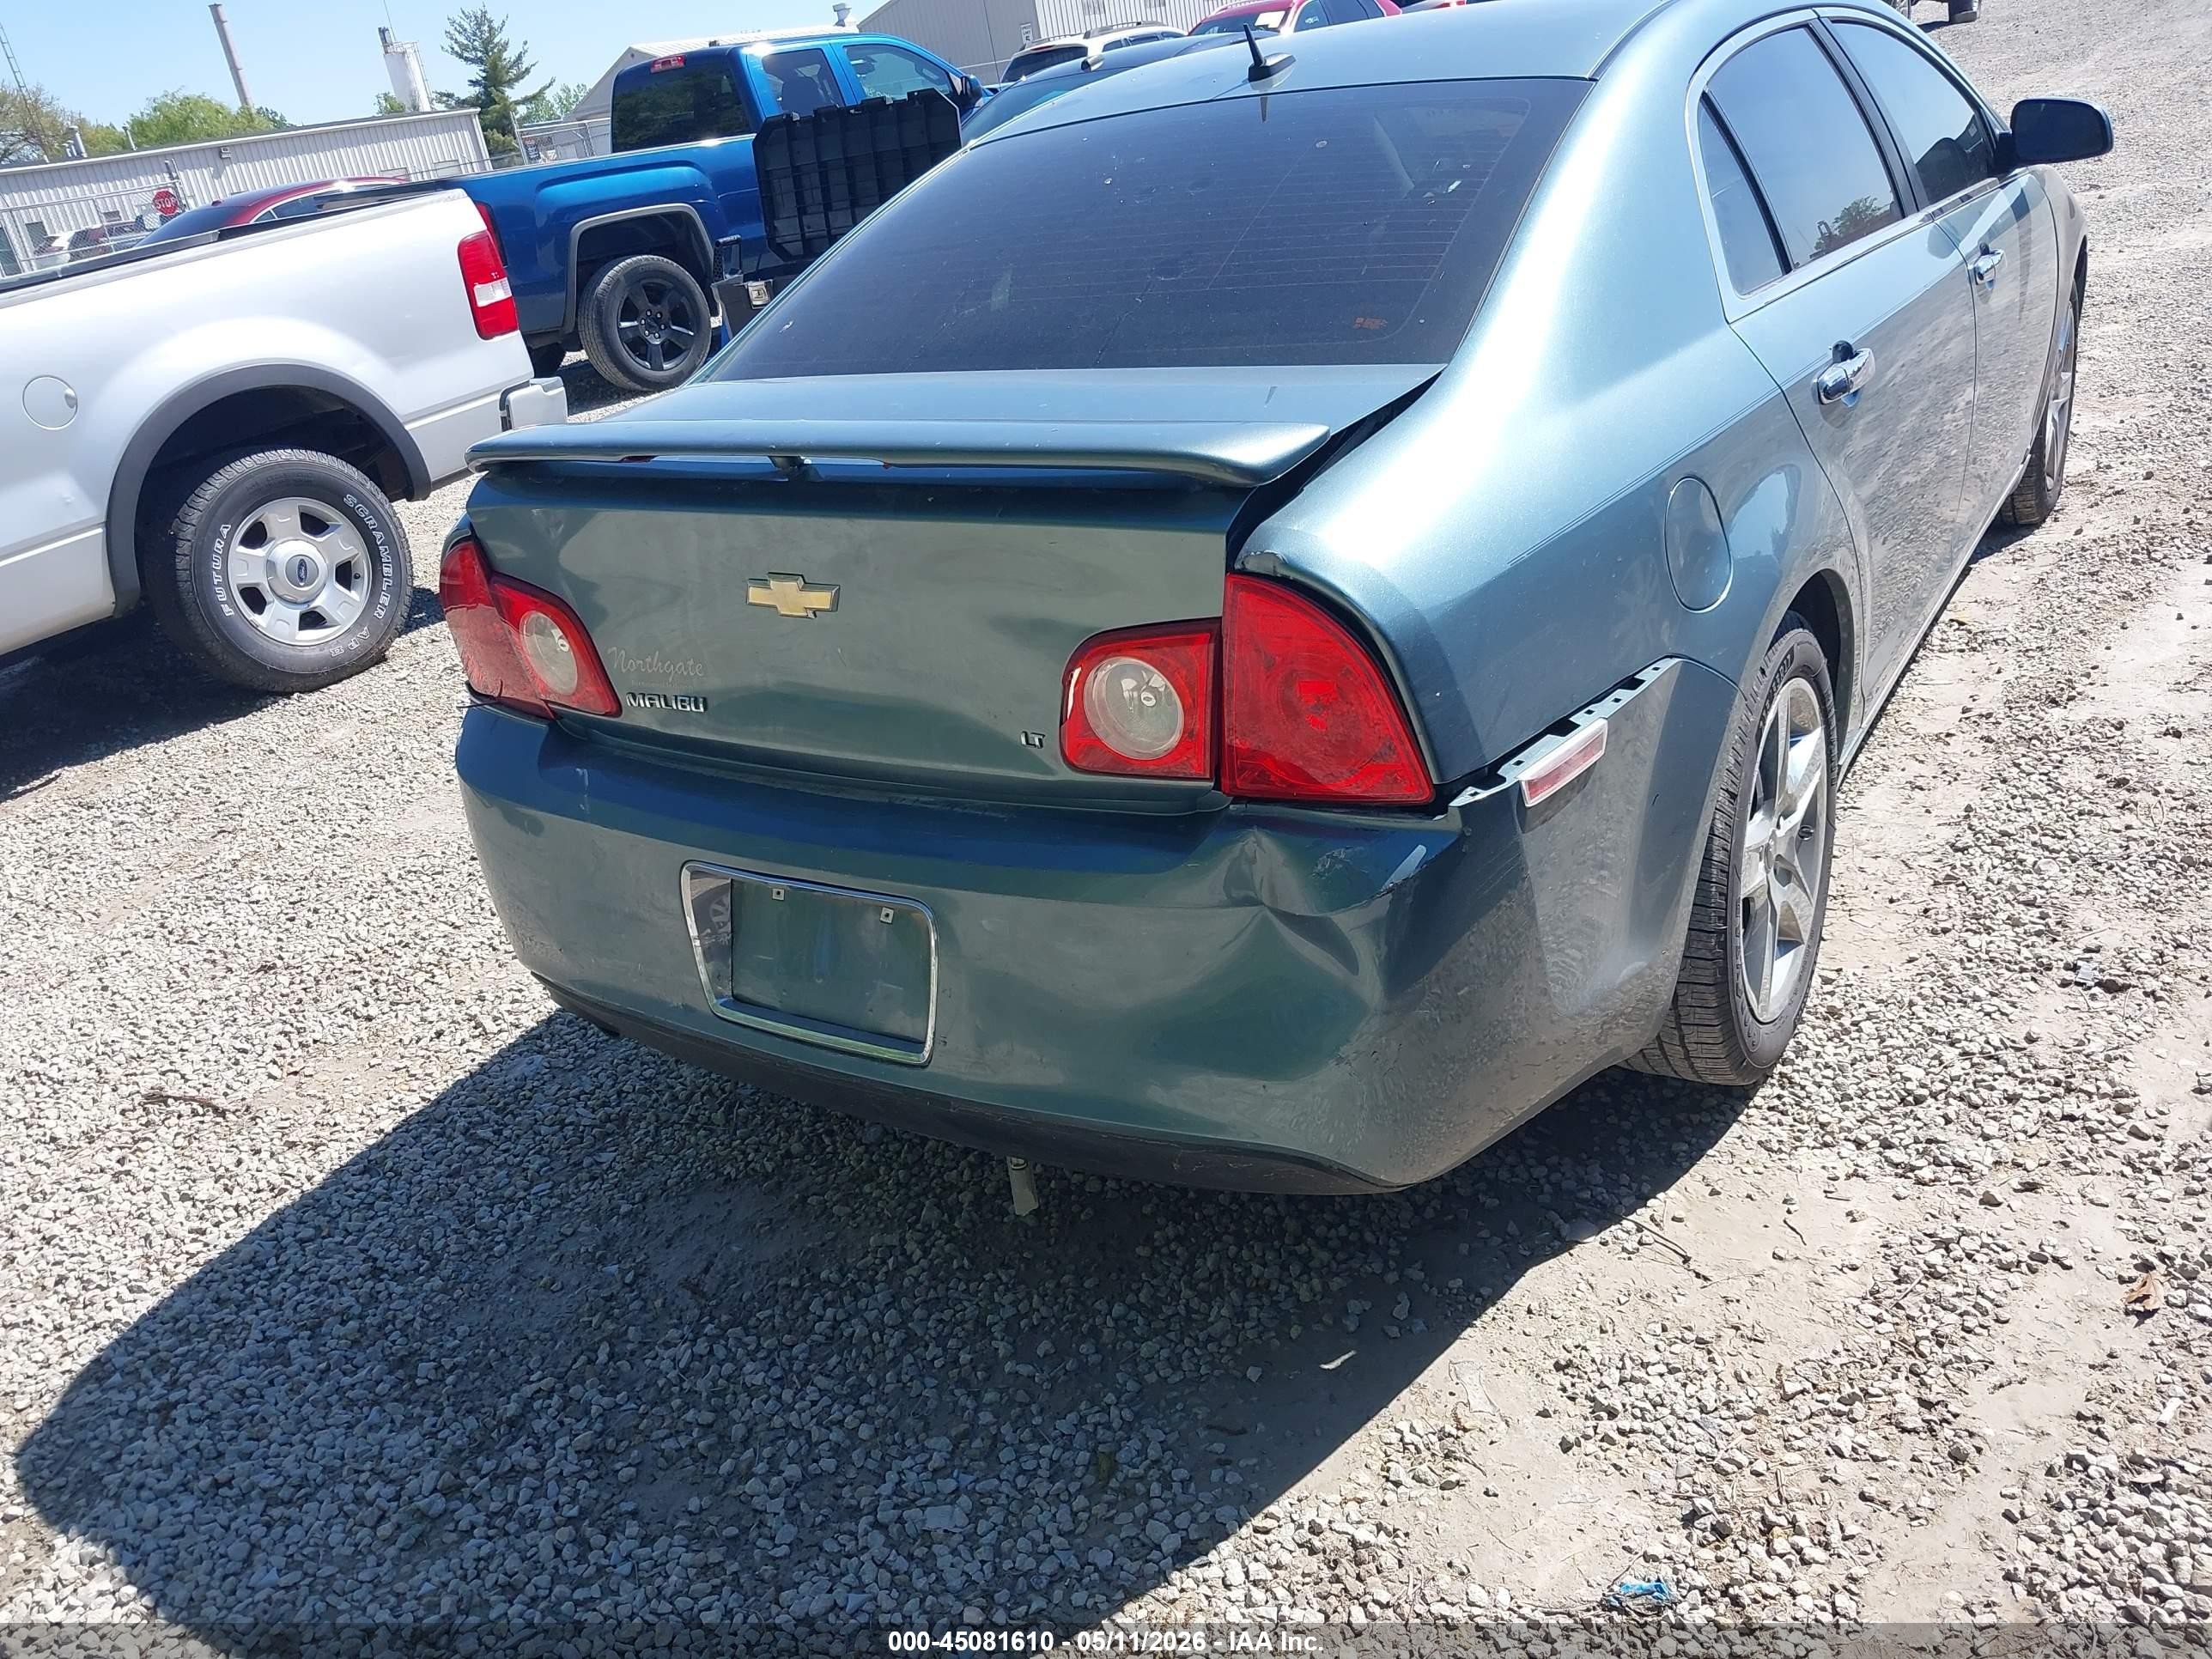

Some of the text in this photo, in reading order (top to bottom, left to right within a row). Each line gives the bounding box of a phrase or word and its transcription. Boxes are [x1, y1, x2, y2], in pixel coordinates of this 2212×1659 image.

[155, 197, 178, 210] STOP
[343, 494, 393, 620] SCRAMBLER
[212, 524, 234, 617] FUTURA
[348, 626, 370, 650] AP
[608, 647, 704, 683] Northgate
[625, 692, 708, 713] MALIBU
[1021, 730, 1045, 749] LT
